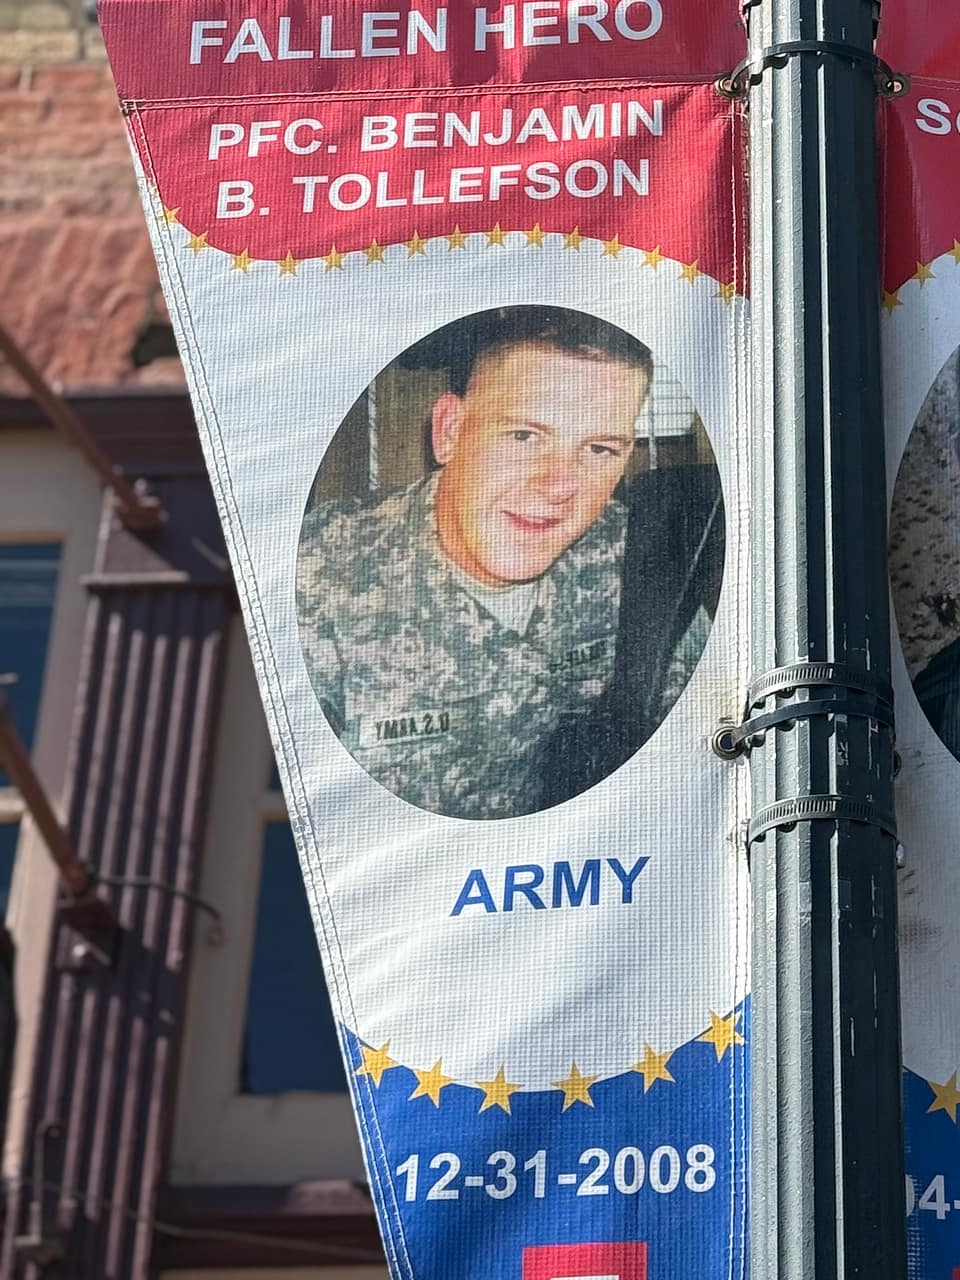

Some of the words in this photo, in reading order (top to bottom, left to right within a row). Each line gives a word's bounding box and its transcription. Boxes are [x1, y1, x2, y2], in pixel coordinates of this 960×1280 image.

[189, 8, 448, 65] FALLEN
[208, 114, 338, 161] PFC.
[360, 98, 664, 153] BENJAMIN
[216, 179, 270, 220] B.
[292, 158, 650, 213] TOLLEFSON
[450, 856, 651, 916] ARMY
[395, 1143, 717, 1202] 12-31-2008
